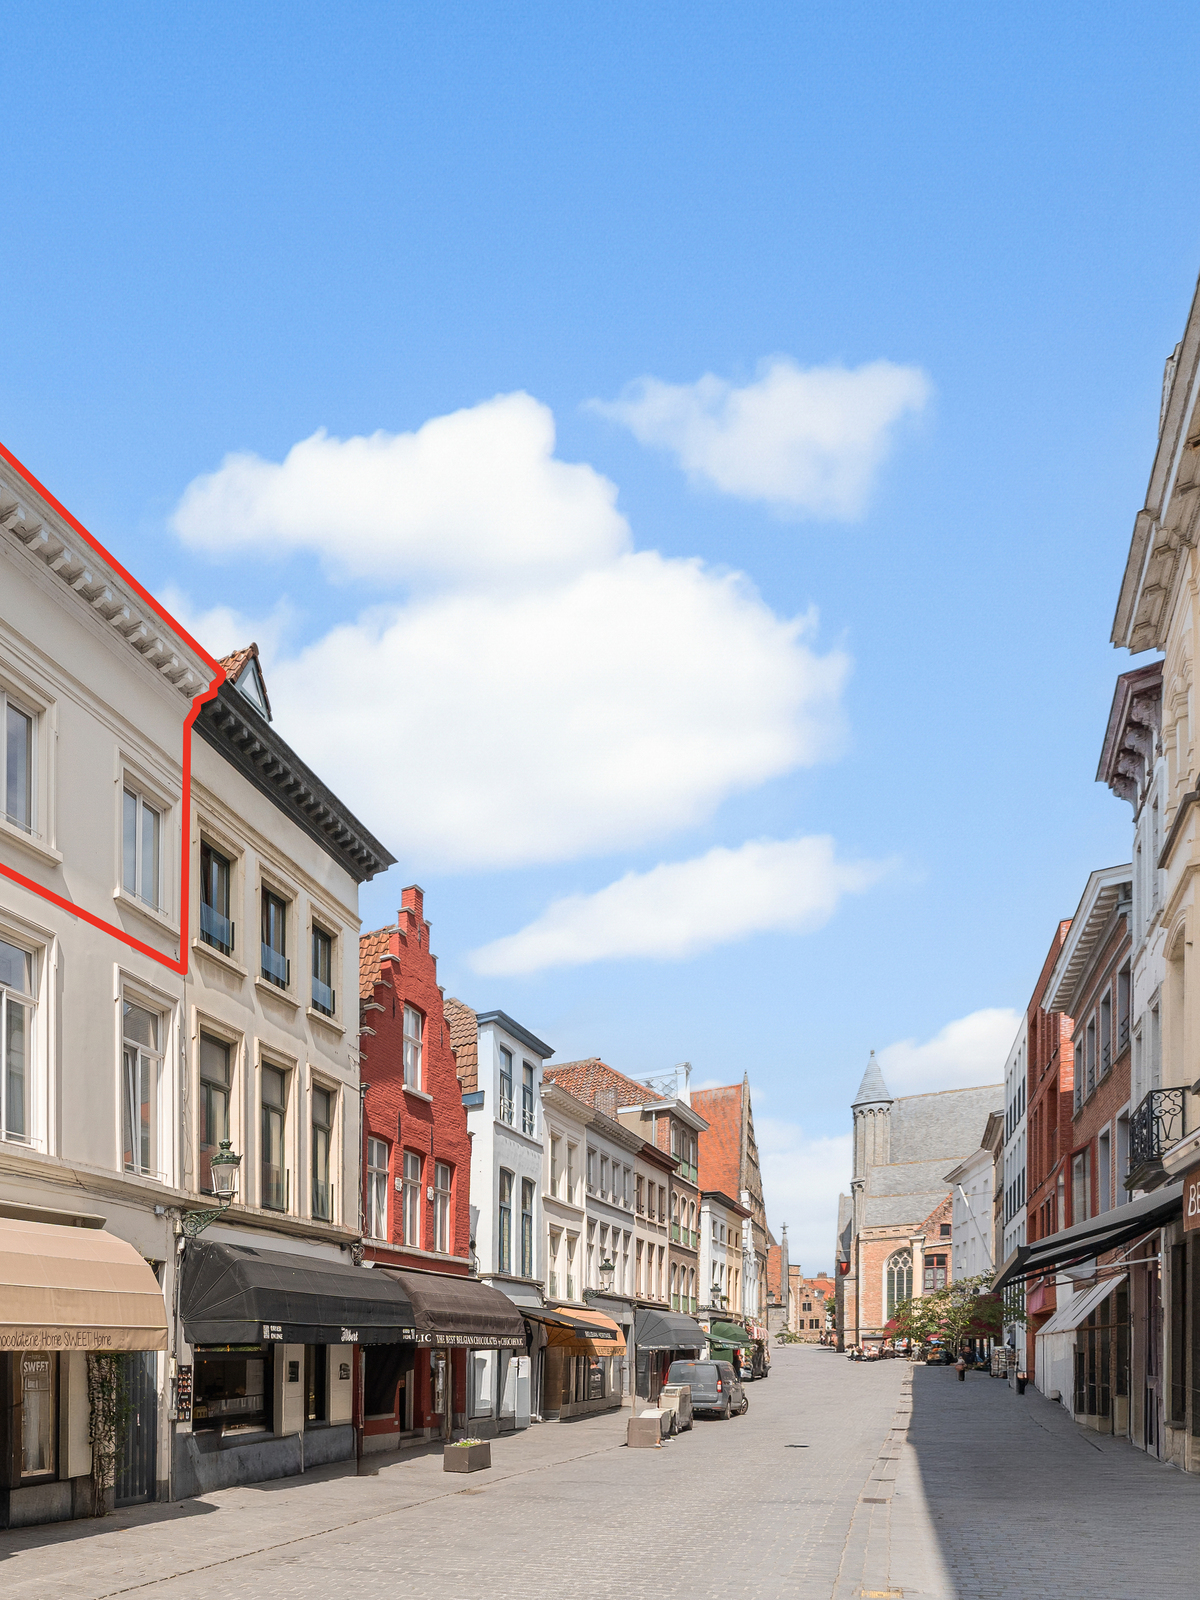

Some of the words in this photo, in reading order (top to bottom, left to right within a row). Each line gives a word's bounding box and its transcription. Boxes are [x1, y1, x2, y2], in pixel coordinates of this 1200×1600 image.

[64, 1331, 92, 1347] SWEET
[93, 1331, 112, 1347] Home
[23, 1361, 49, 1373] SWEET
